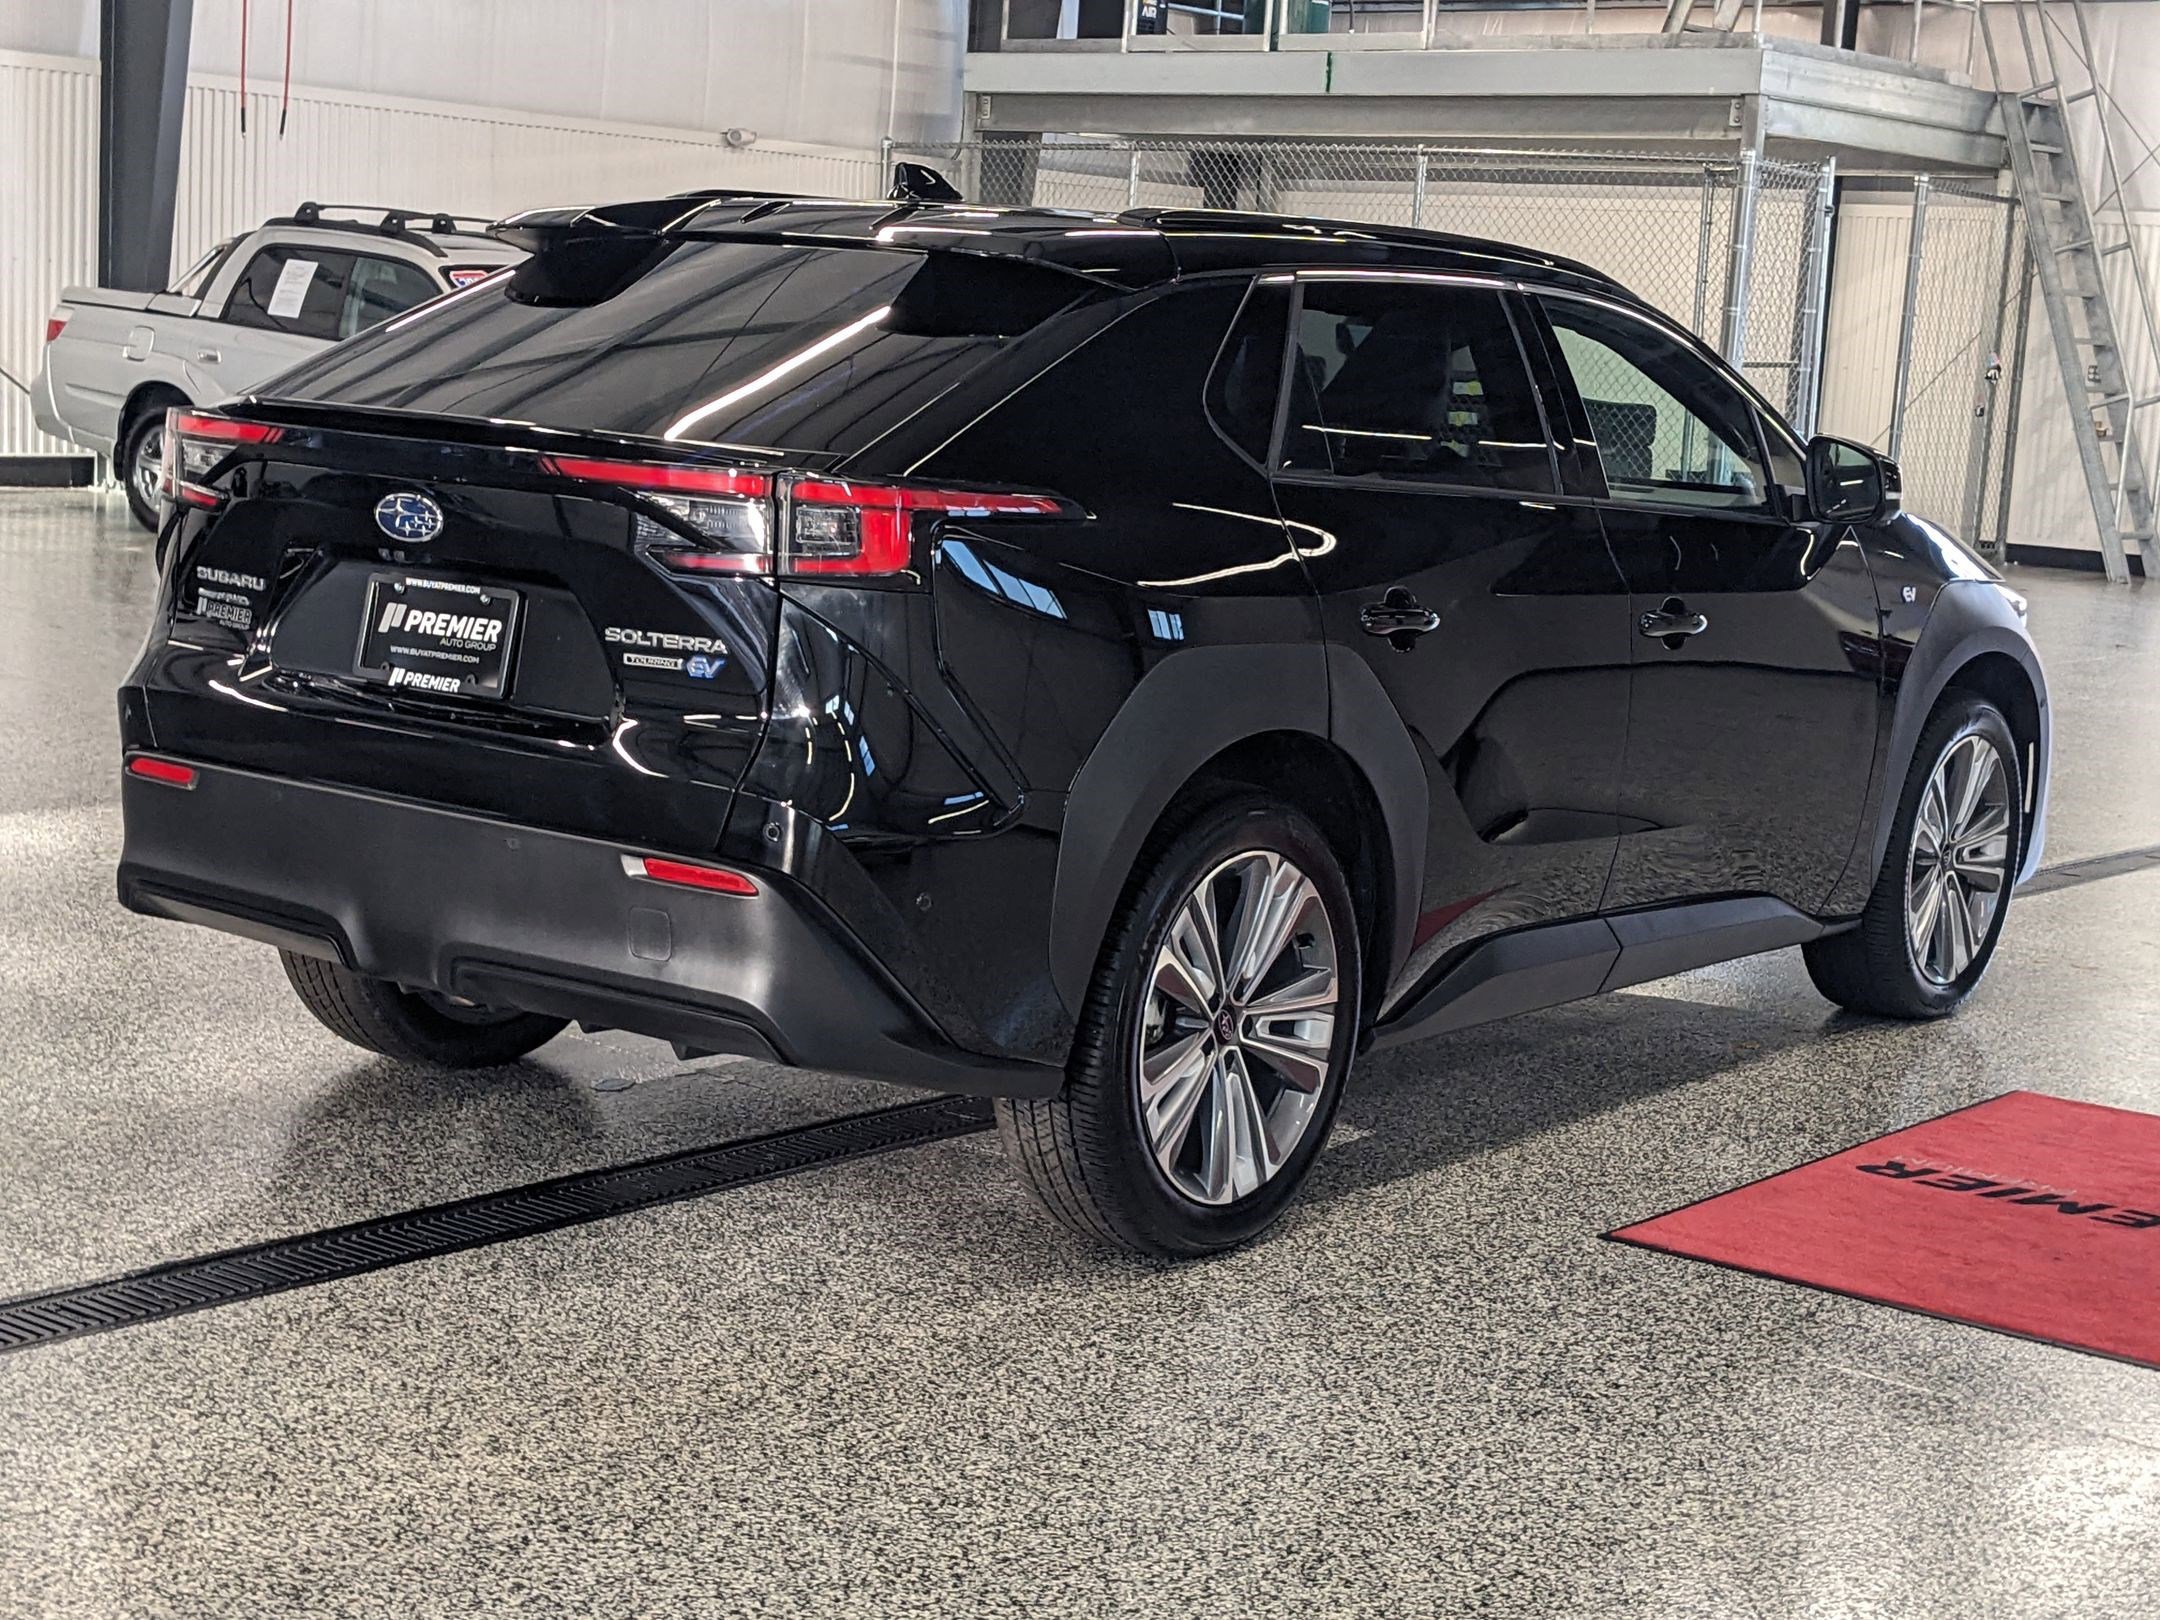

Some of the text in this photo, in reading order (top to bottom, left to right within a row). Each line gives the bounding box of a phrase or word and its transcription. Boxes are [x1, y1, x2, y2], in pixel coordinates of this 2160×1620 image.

[197, 566, 265, 591] SUBARU
[405, 577, 481, 595] WWW.BUYATPREMIER.COM
[206, 601, 253, 625] PREMIER
[404, 609, 503, 643] PREMIER
[440, 637, 497, 652] AUTO GROUP
[605, 626, 728, 654] SOLTERRA
[390, 645, 480, 664] WWW.BUYATPREMIER.COM
[686, 655, 726, 679] EV
[404, 671, 461, 693] PREMIER
